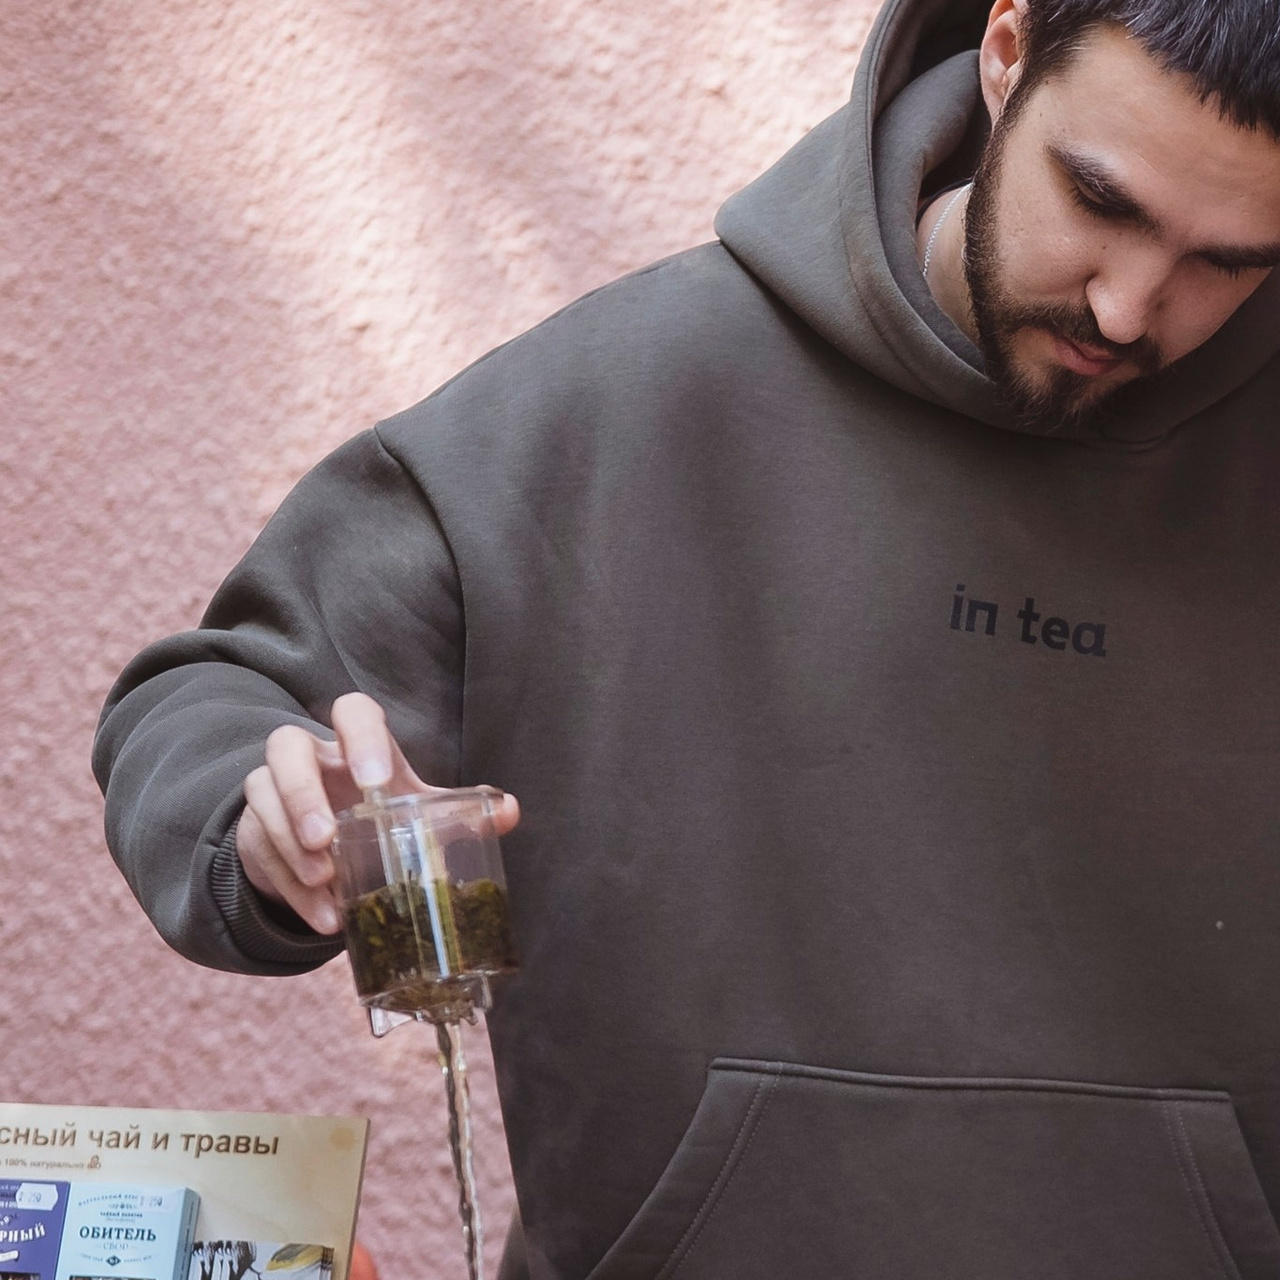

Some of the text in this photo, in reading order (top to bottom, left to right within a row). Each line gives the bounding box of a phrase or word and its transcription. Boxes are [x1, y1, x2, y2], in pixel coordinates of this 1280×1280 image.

[950, 584, 1106, 657] in tea
[89, 1124, 141, 1151] чай
[151, 1132, 170, 1151] и
[180, 1132, 279, 1158] травы
[79, 1225, 157, 1242] ОБИТЕЛЬ
